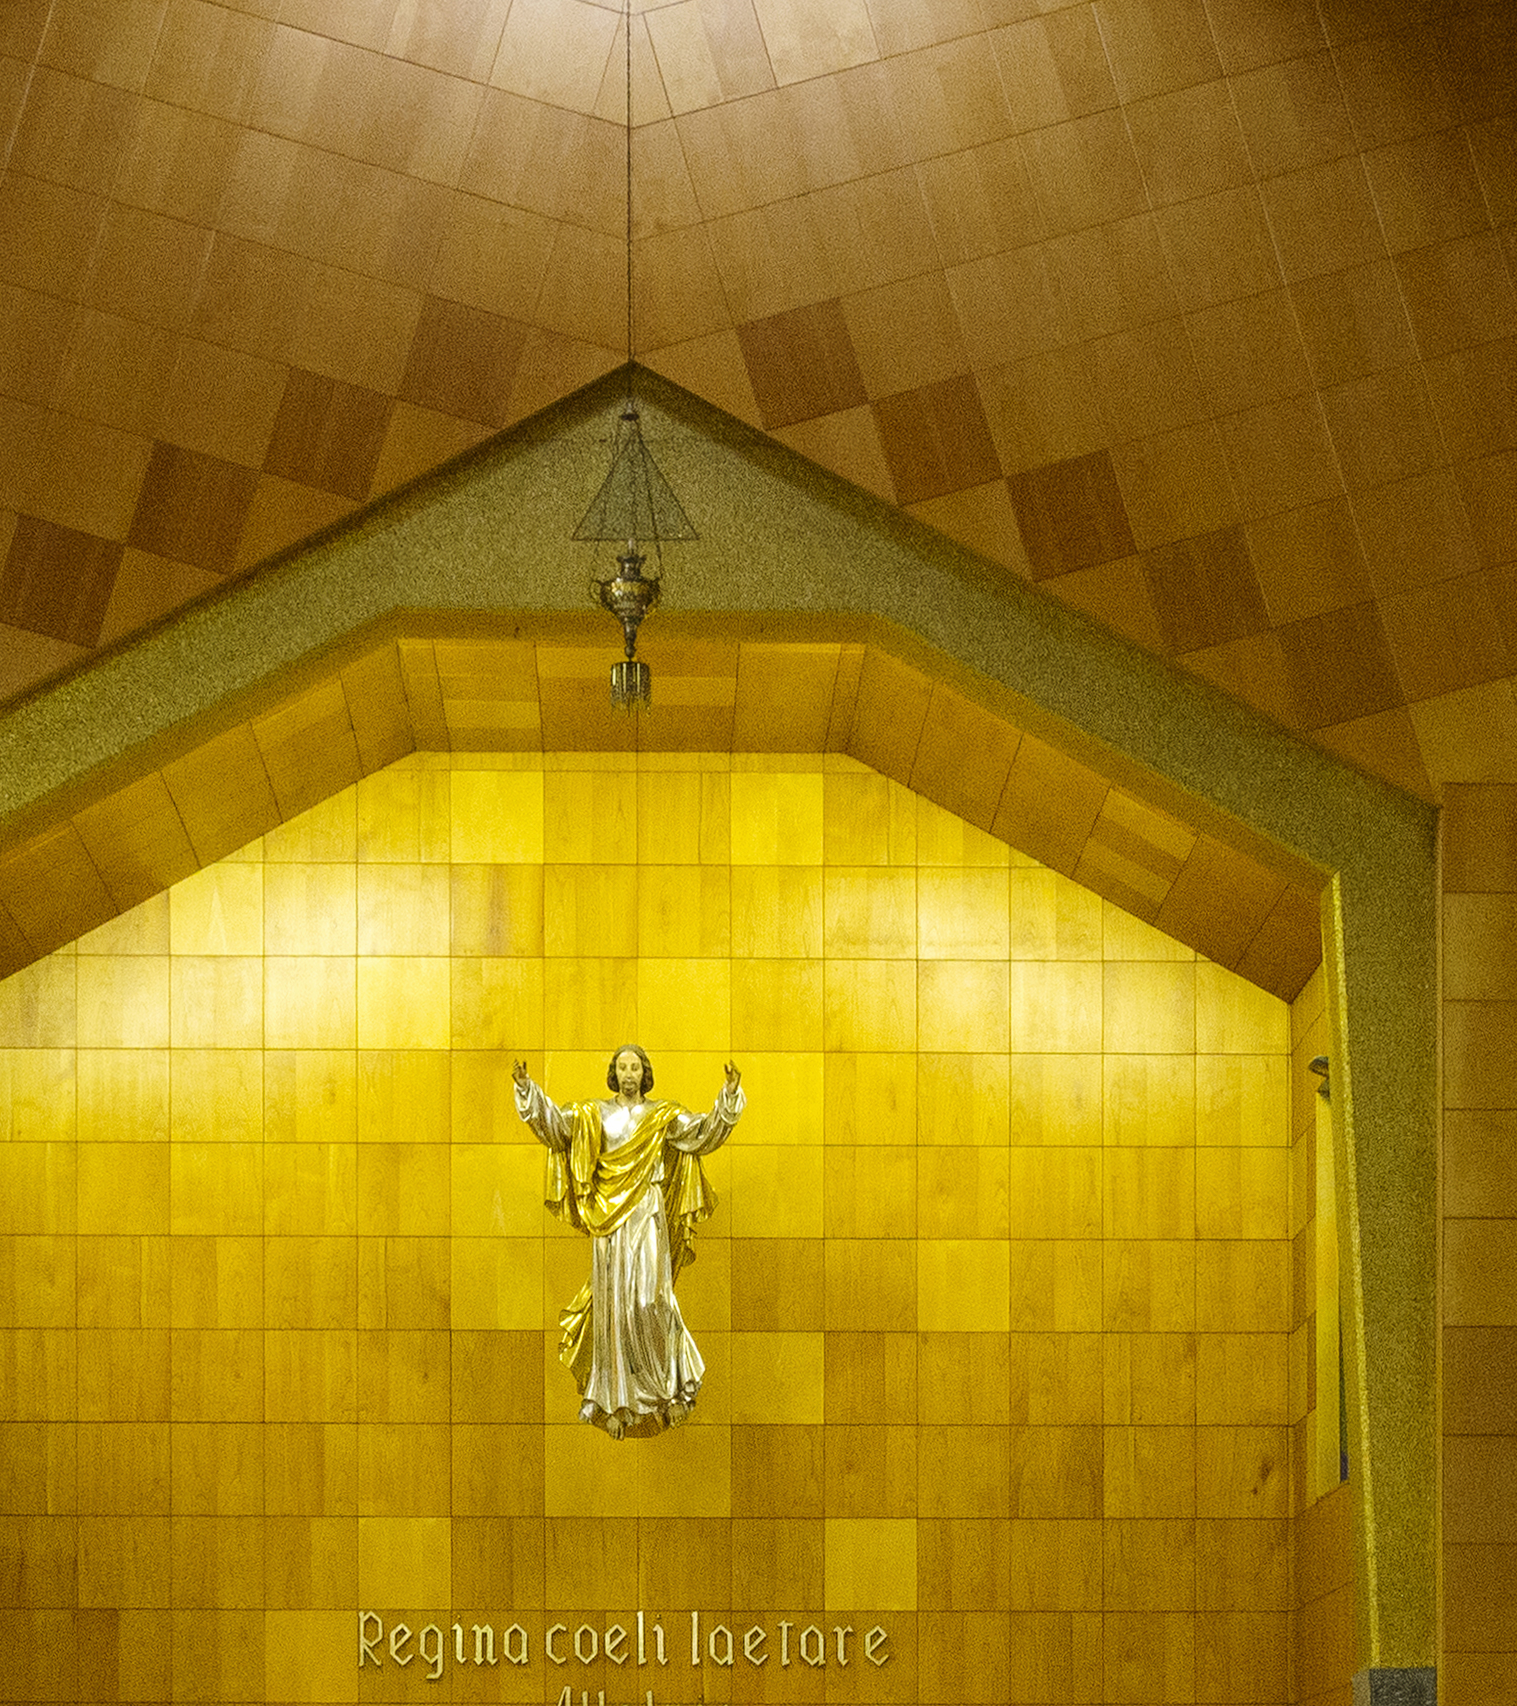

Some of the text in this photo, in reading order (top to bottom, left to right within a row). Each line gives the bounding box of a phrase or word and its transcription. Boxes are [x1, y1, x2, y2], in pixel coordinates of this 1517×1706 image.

[358, 1610, 890, 1680] Regina coeli laetare
